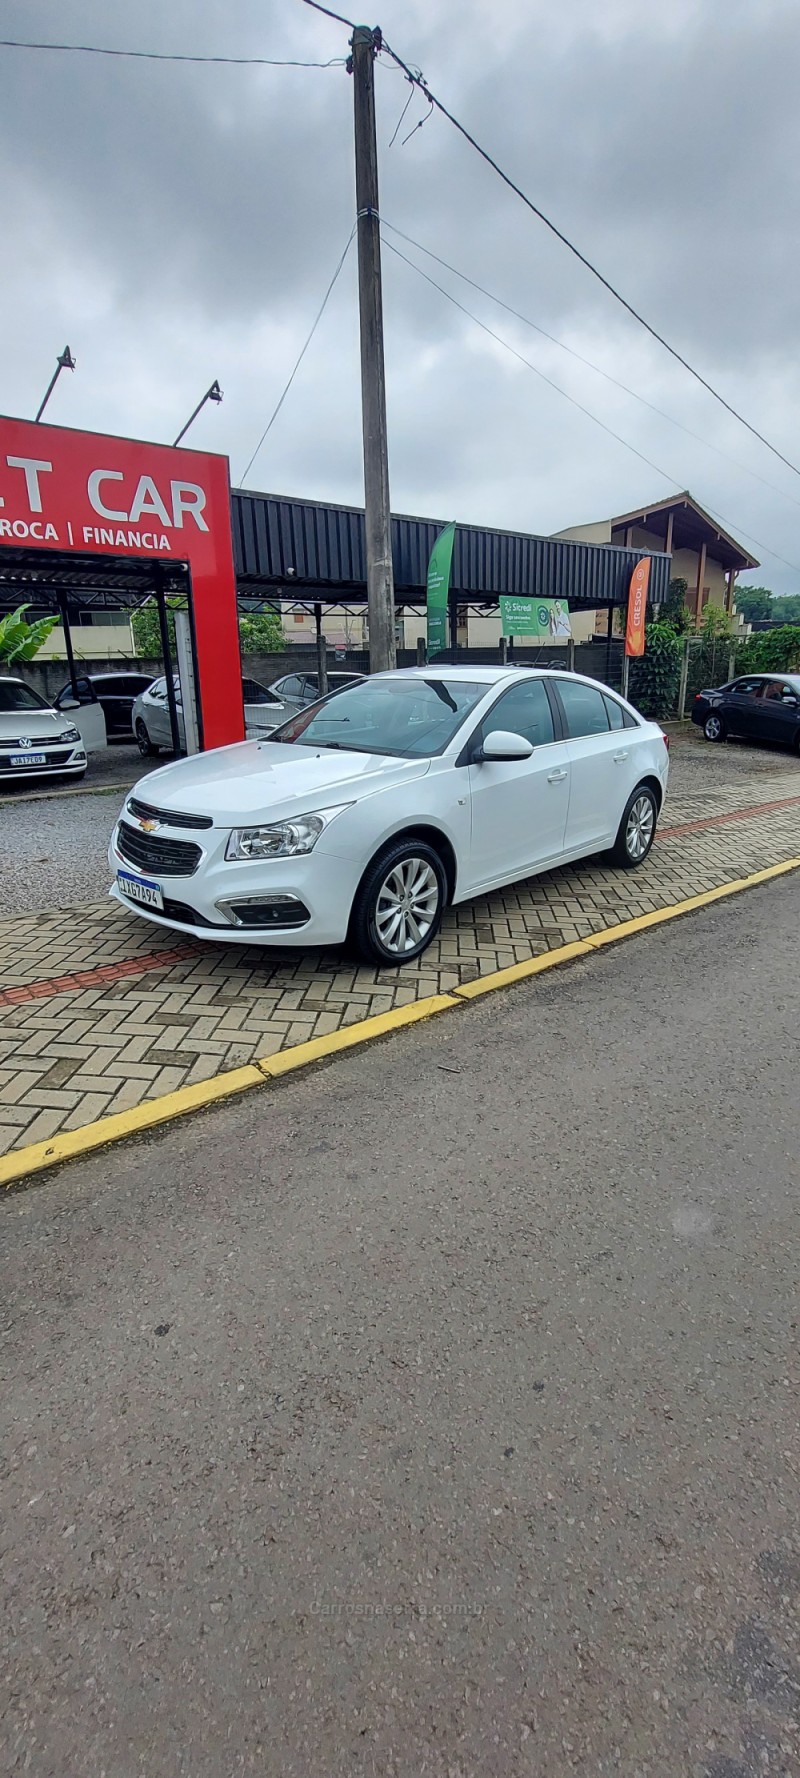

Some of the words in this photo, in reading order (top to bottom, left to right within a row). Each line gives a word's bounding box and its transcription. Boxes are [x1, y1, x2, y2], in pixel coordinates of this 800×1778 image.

[0, 455, 53, 513] T
[87, 469, 210, 532] CAR
[0, 518, 59, 541] ROCA
[82, 526, 171, 550] FINANCIA
[512, 603, 532, 612] Sicredi
[634, 585, 643, 626] CRESOL
